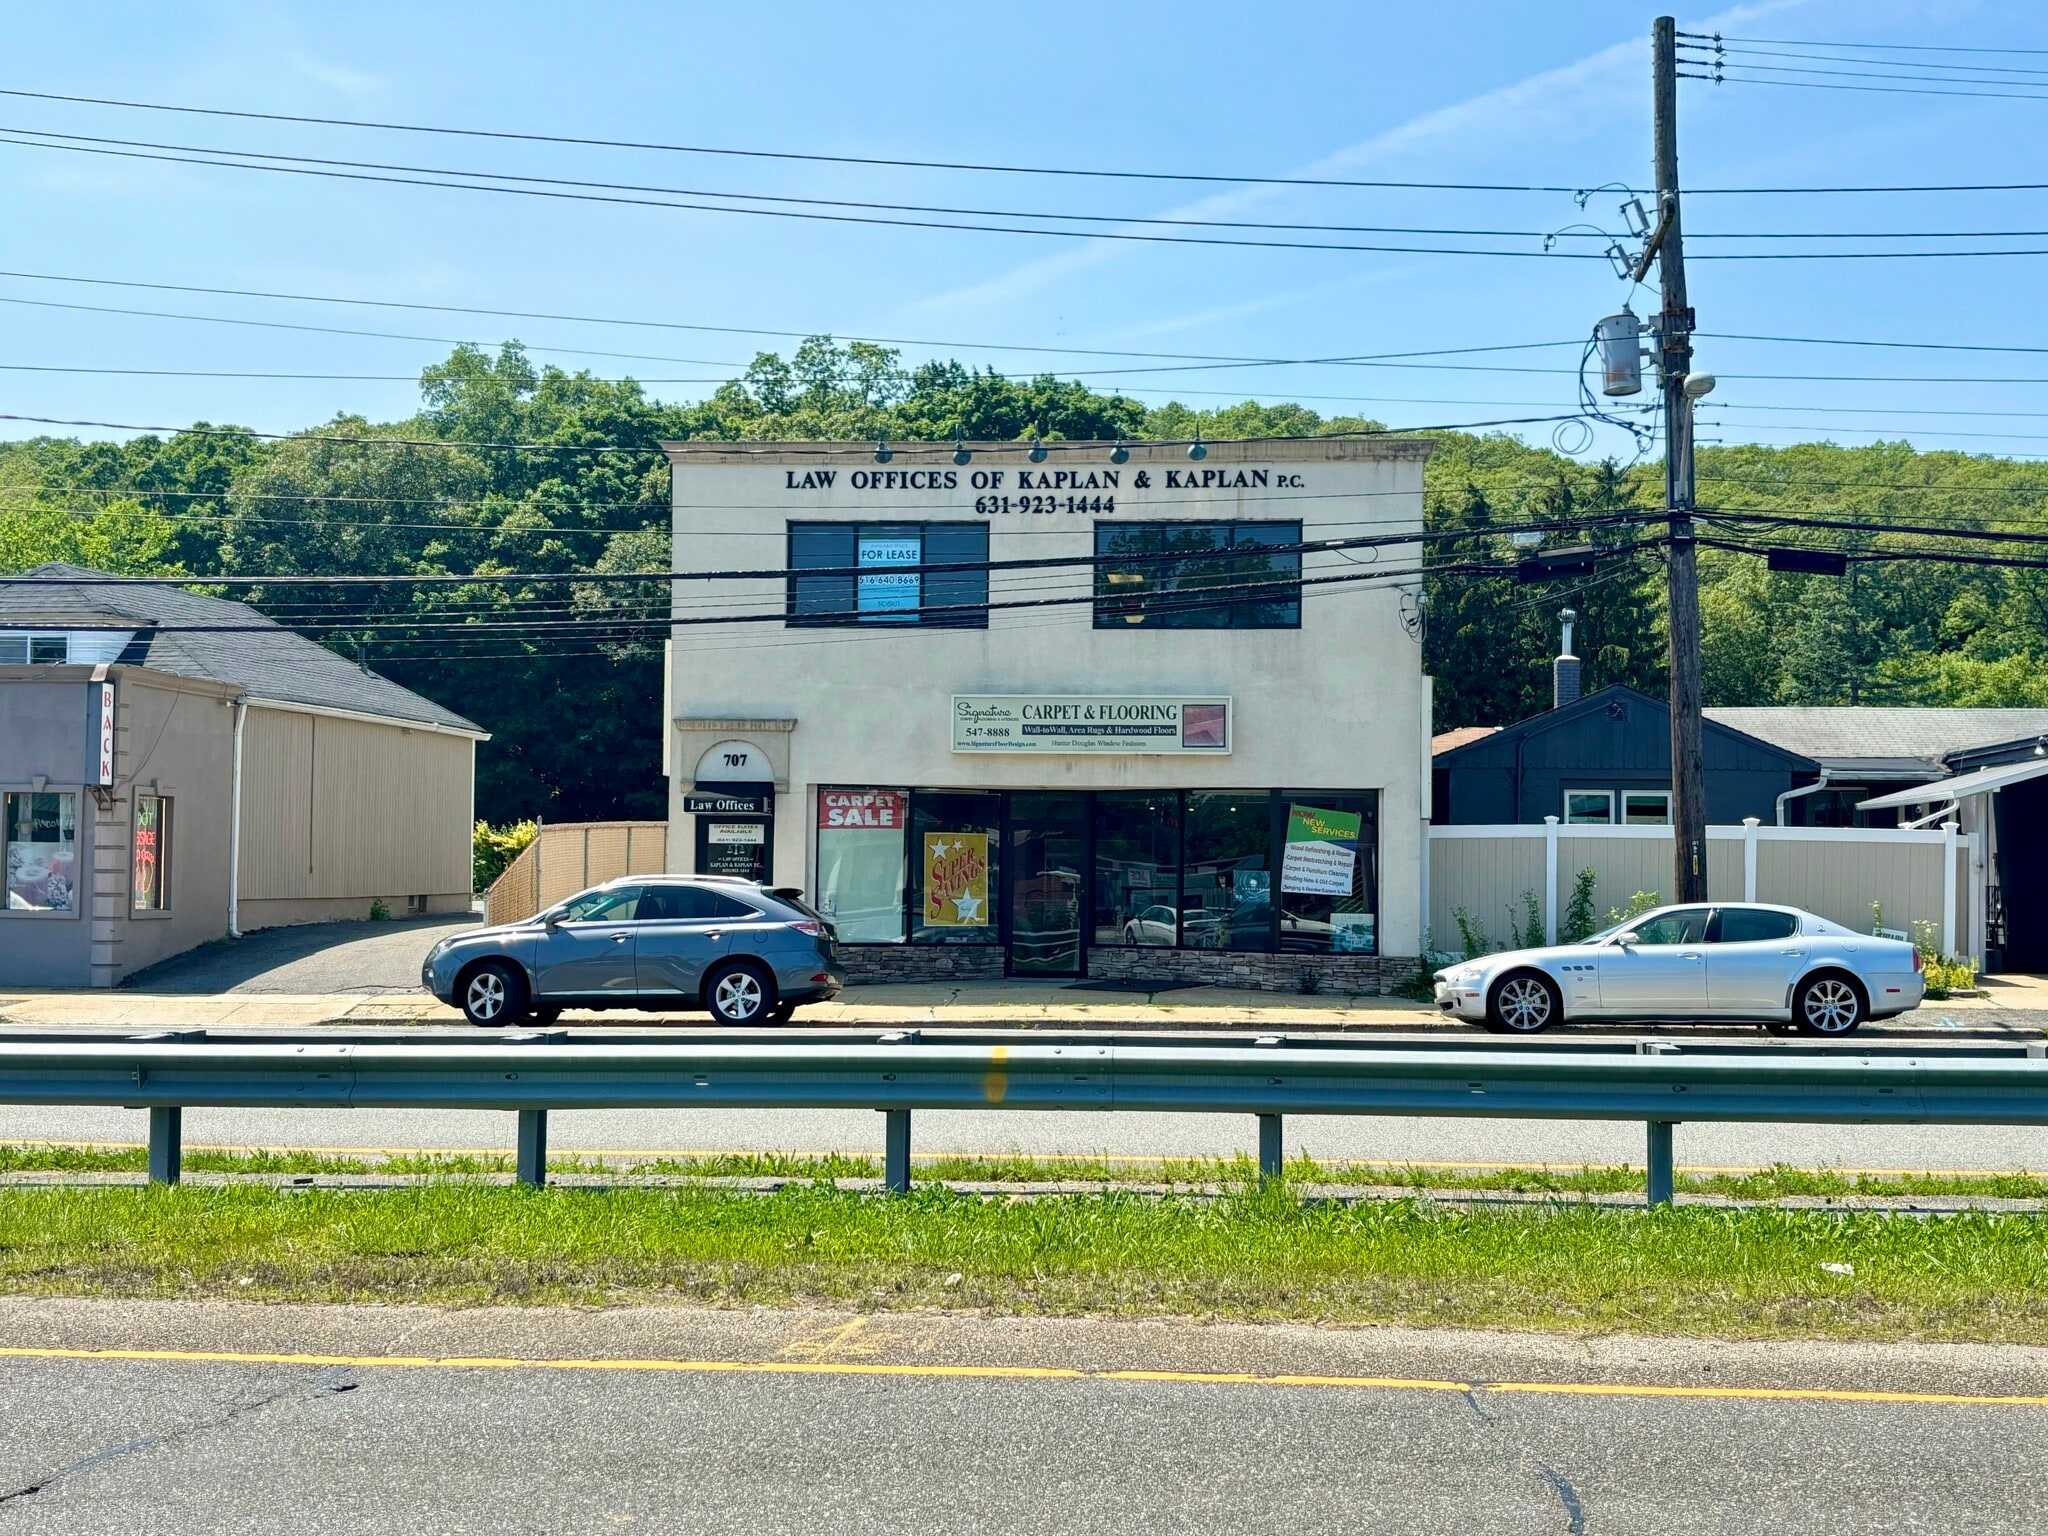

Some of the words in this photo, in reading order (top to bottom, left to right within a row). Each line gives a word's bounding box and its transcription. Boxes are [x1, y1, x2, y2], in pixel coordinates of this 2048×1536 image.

[785, 471, 837, 489] LAW
[851, 471, 958, 489] OFFICES
[970, 471, 1004, 489] OF
[1017, 470, 1120, 489] KAPLAN
[1134, 470, 1152, 489] &
[1165, 469, 1270, 488] KAPLAN
[1276, 475, 1305, 488] P.C.
[975, 495, 1115, 514] 631-923-1444
[861, 550, 883, 560] FOR
[886, 550, 918, 560] LEASE
[957, 701, 1012, 724] Signature
[1022, 704, 1081, 720] CARPET
[1083, 704, 1096, 720] &
[1099, 704, 1178, 720] FLOORING
[965, 727, 1010, 737] 547-8888
[1087, 726, 1105, 736] Rugs
[1106, 726, 1113, 734] &
[1114, 726, 1153, 734] Hardwood
[1153, 726, 1177, 735] Floors
[1071, 740, 1096, 748] Douglas
[723, 754, 748, 767] 707
[690, 799, 714, 810] Law
[716, 799, 755, 811] Offices
[825, 794, 895, 808] CARPET
[828, 808, 894, 827] SALE
[1302, 817, 1326, 827] NEW
[1311, 826, 1356, 839] SERVICES
[1290, 844, 1304, 852] Wood
[1286, 854, 1302, 862] Carpet
[931, 847, 975, 892] SUPER
[1284, 864, 1301, 872] Carpet
[1328, 869, 1349, 879] Cleaning
